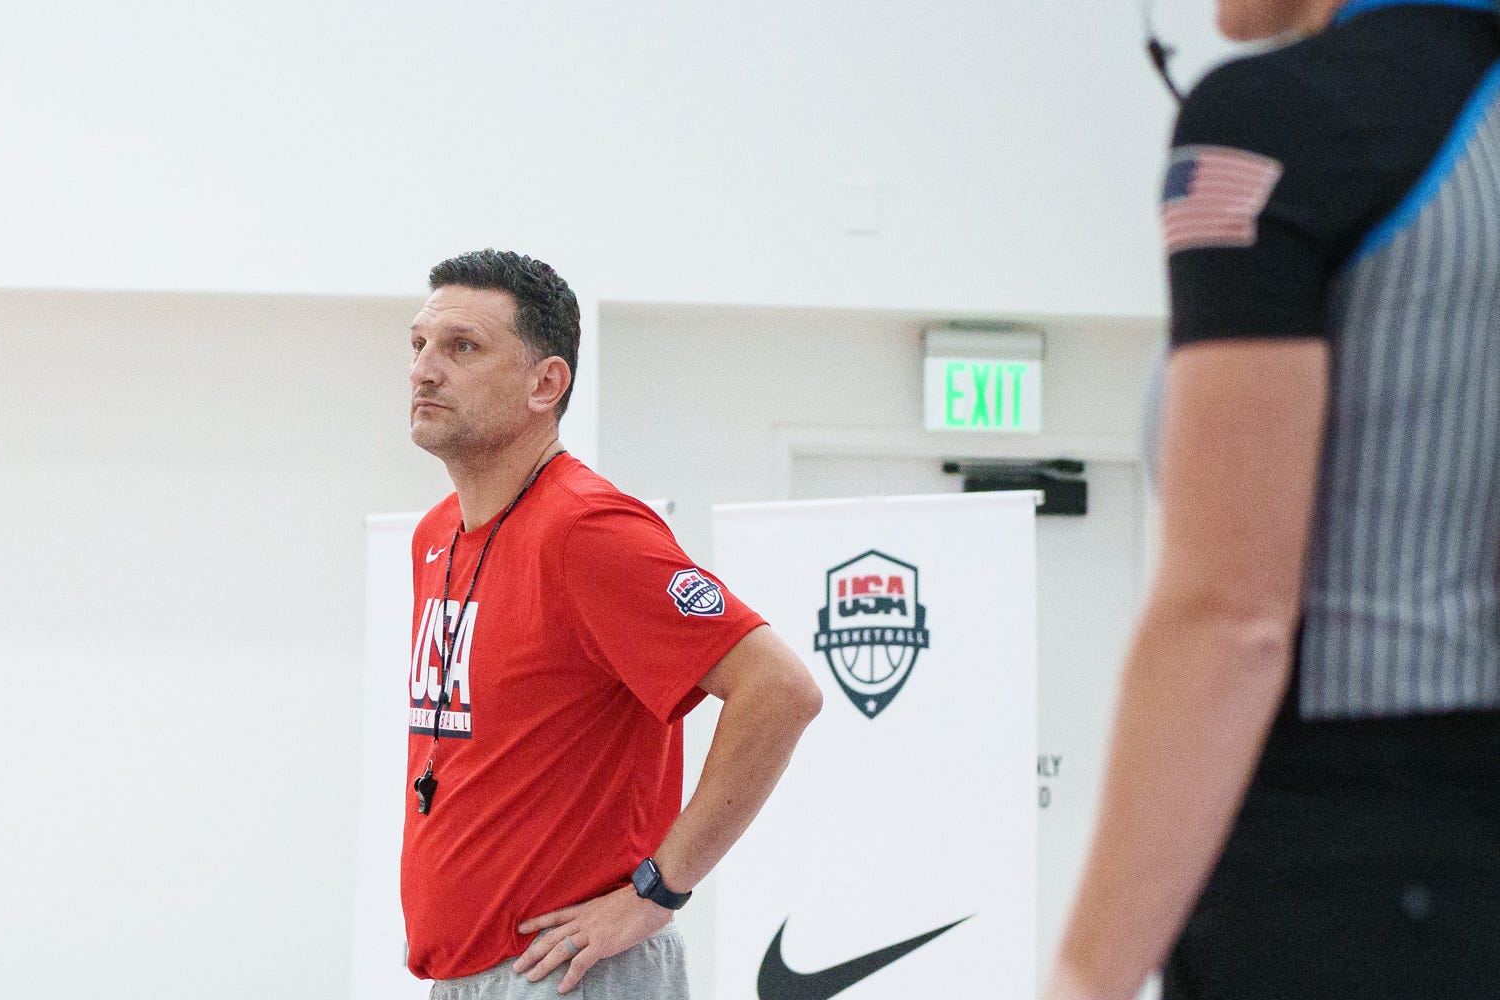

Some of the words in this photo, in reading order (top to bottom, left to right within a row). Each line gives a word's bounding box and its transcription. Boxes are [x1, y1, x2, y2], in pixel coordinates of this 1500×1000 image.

[945, 362, 1029, 428] EXIT
[838, 574, 908, 617] USA
[410, 598, 479, 706] USA
[817, 628, 924, 647] BASKETBALL
[410, 709, 468, 730] BASKBALL
